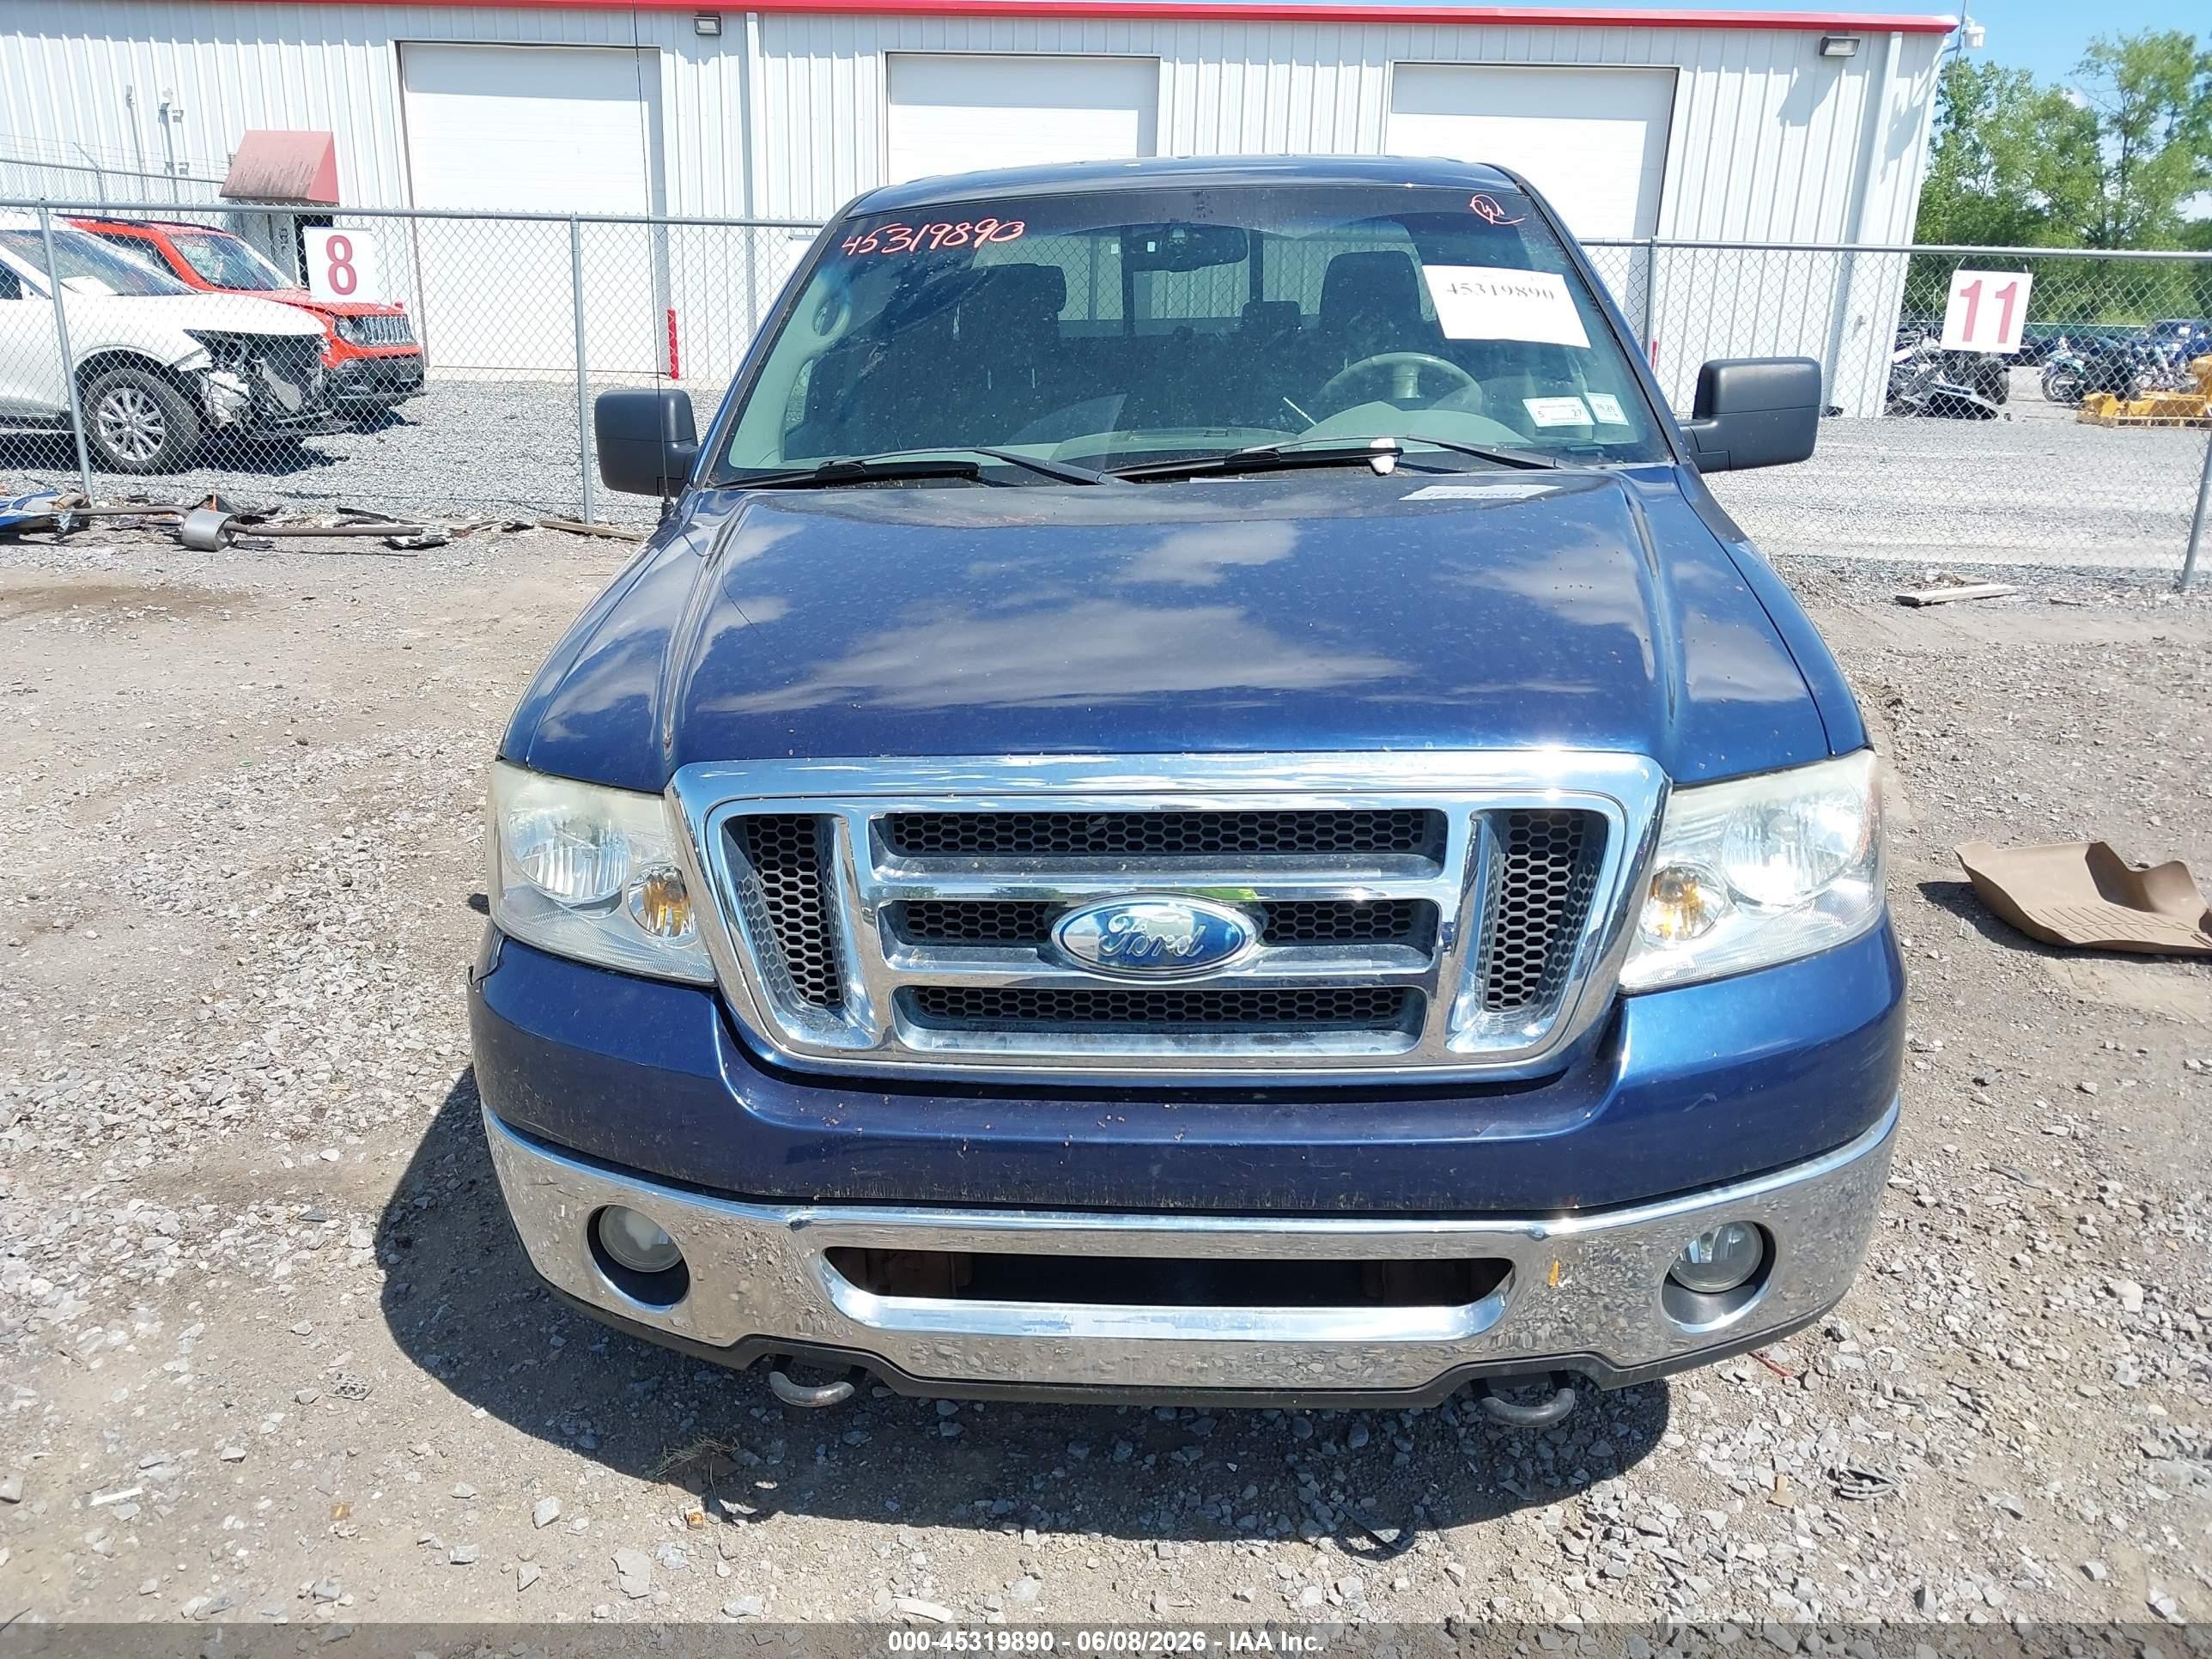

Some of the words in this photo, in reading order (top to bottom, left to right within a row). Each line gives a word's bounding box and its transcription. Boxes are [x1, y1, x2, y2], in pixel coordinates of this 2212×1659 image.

[842, 218, 1025, 256] 45319890
[326, 234, 357, 295] 8
[1446, 282, 1555, 301] 45319890
[1959, 279, 2018, 343] 11
[1098, 913, 1206, 957] Ford
